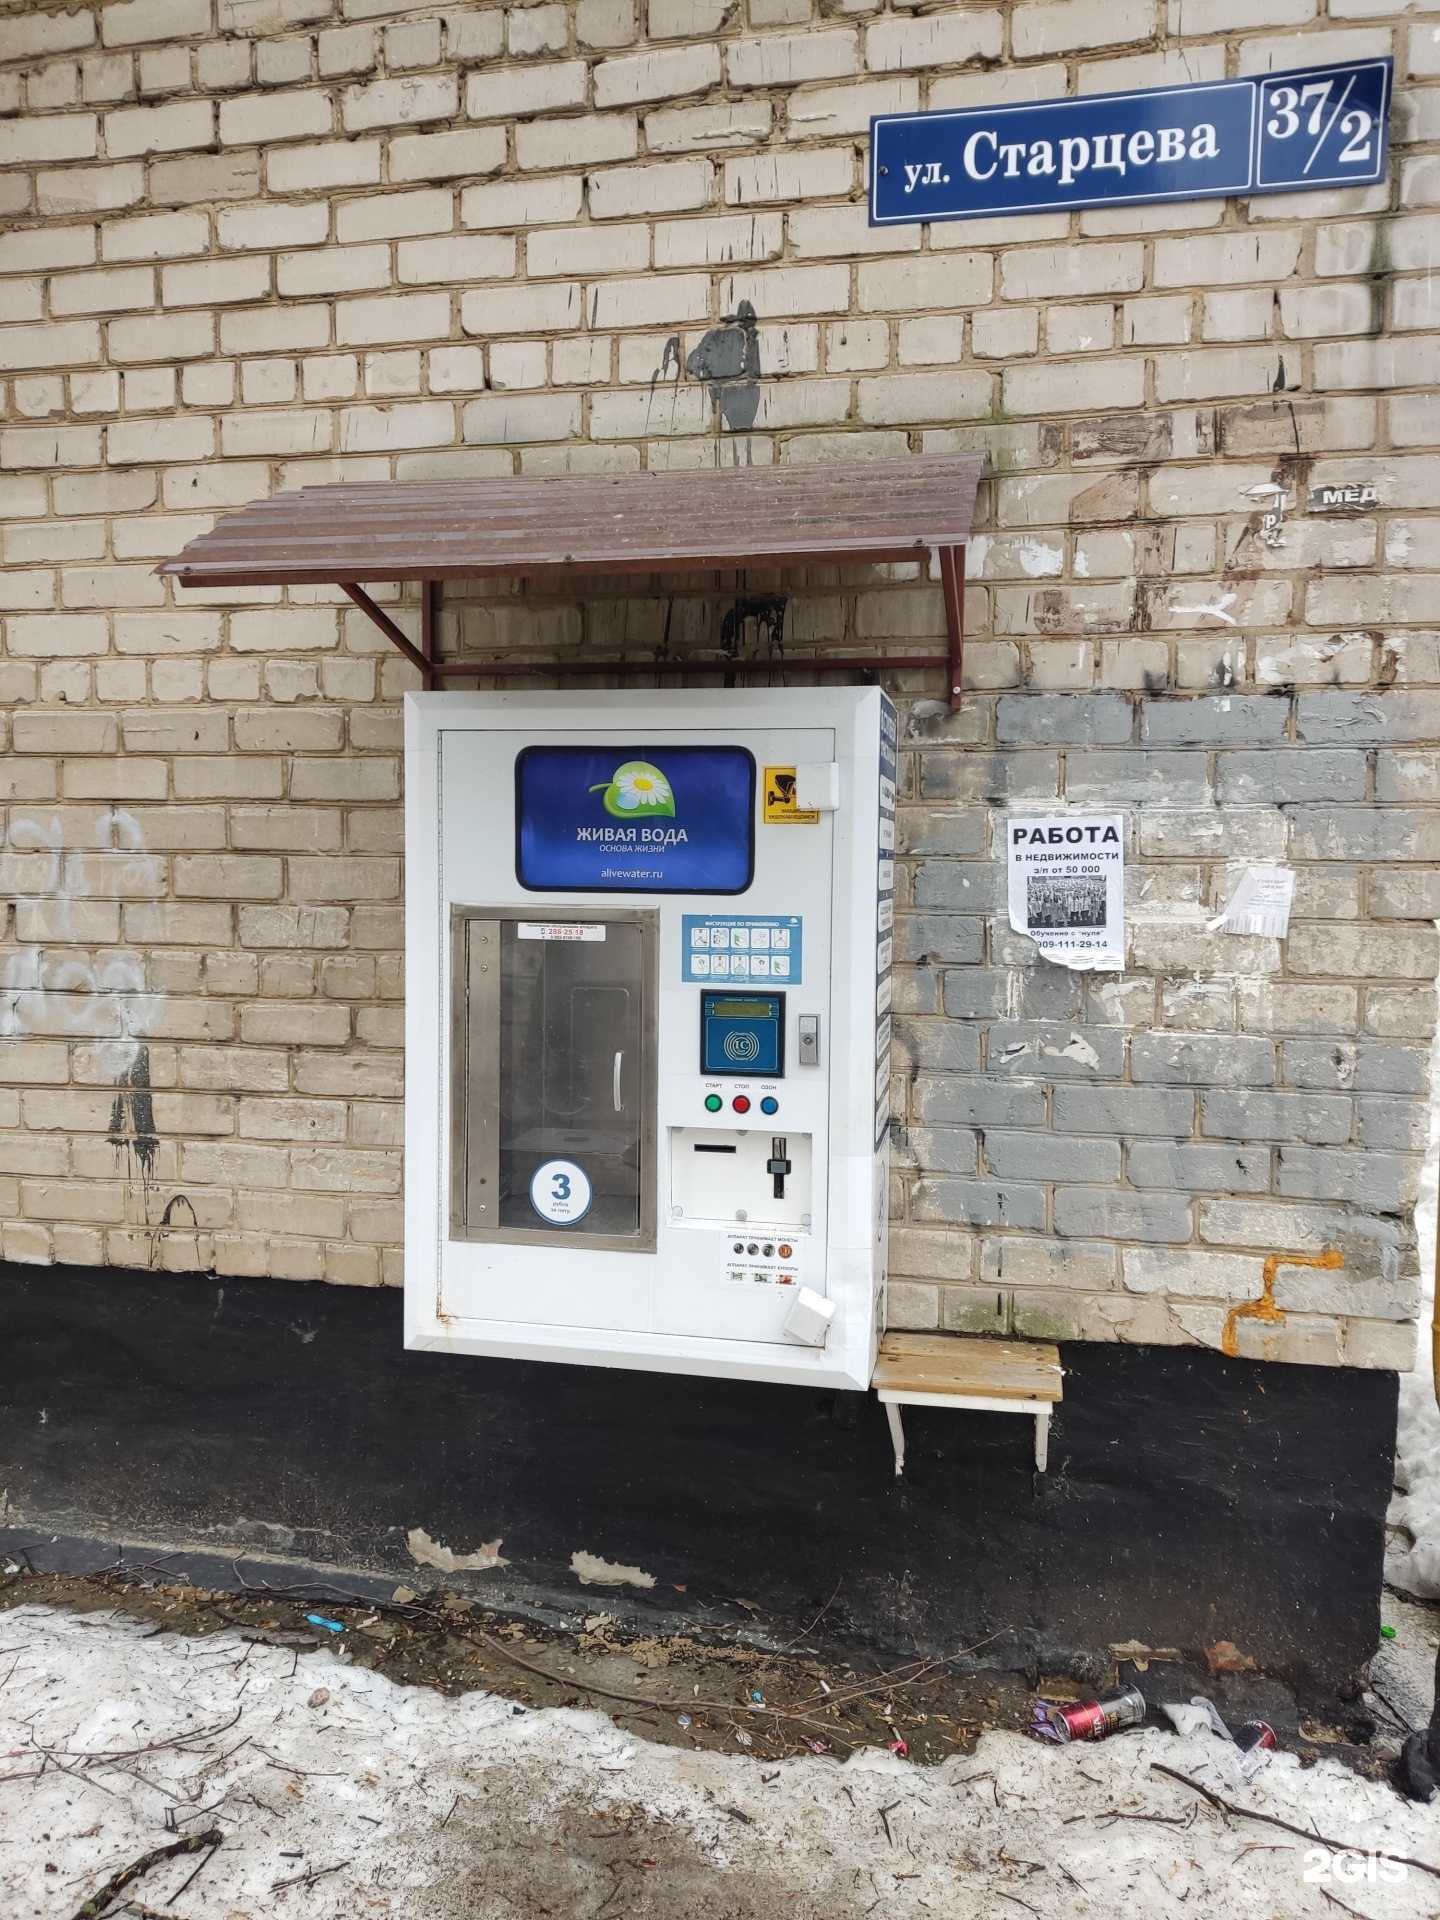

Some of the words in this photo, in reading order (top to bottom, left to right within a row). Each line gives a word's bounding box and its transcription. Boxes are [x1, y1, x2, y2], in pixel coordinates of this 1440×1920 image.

[904, 158, 950, 192] ул.
[963, 122, 1220, 184] Старцева
[1267, 75, 1372, 175] 37/2
[576, 827, 636, 842] ЖИВАЯ
[641, 828, 688, 845] ВОДА
[1013, 826, 1120, 845] РАБОТА
[599, 844, 632, 853] ОСНОВА
[635, 844, 665, 853] ЖИЗНИ
[1025, 852, 1119, 862] НЕДВИЖИМОСТИ
[600, 867, 663, 879] alivewater.ru
[1033, 866, 1049, 874] з/п
[1065, 865, 1078, 873] 50
[1081, 865, 1100, 873] 000
[551, 1173, 571, 1200] 3
